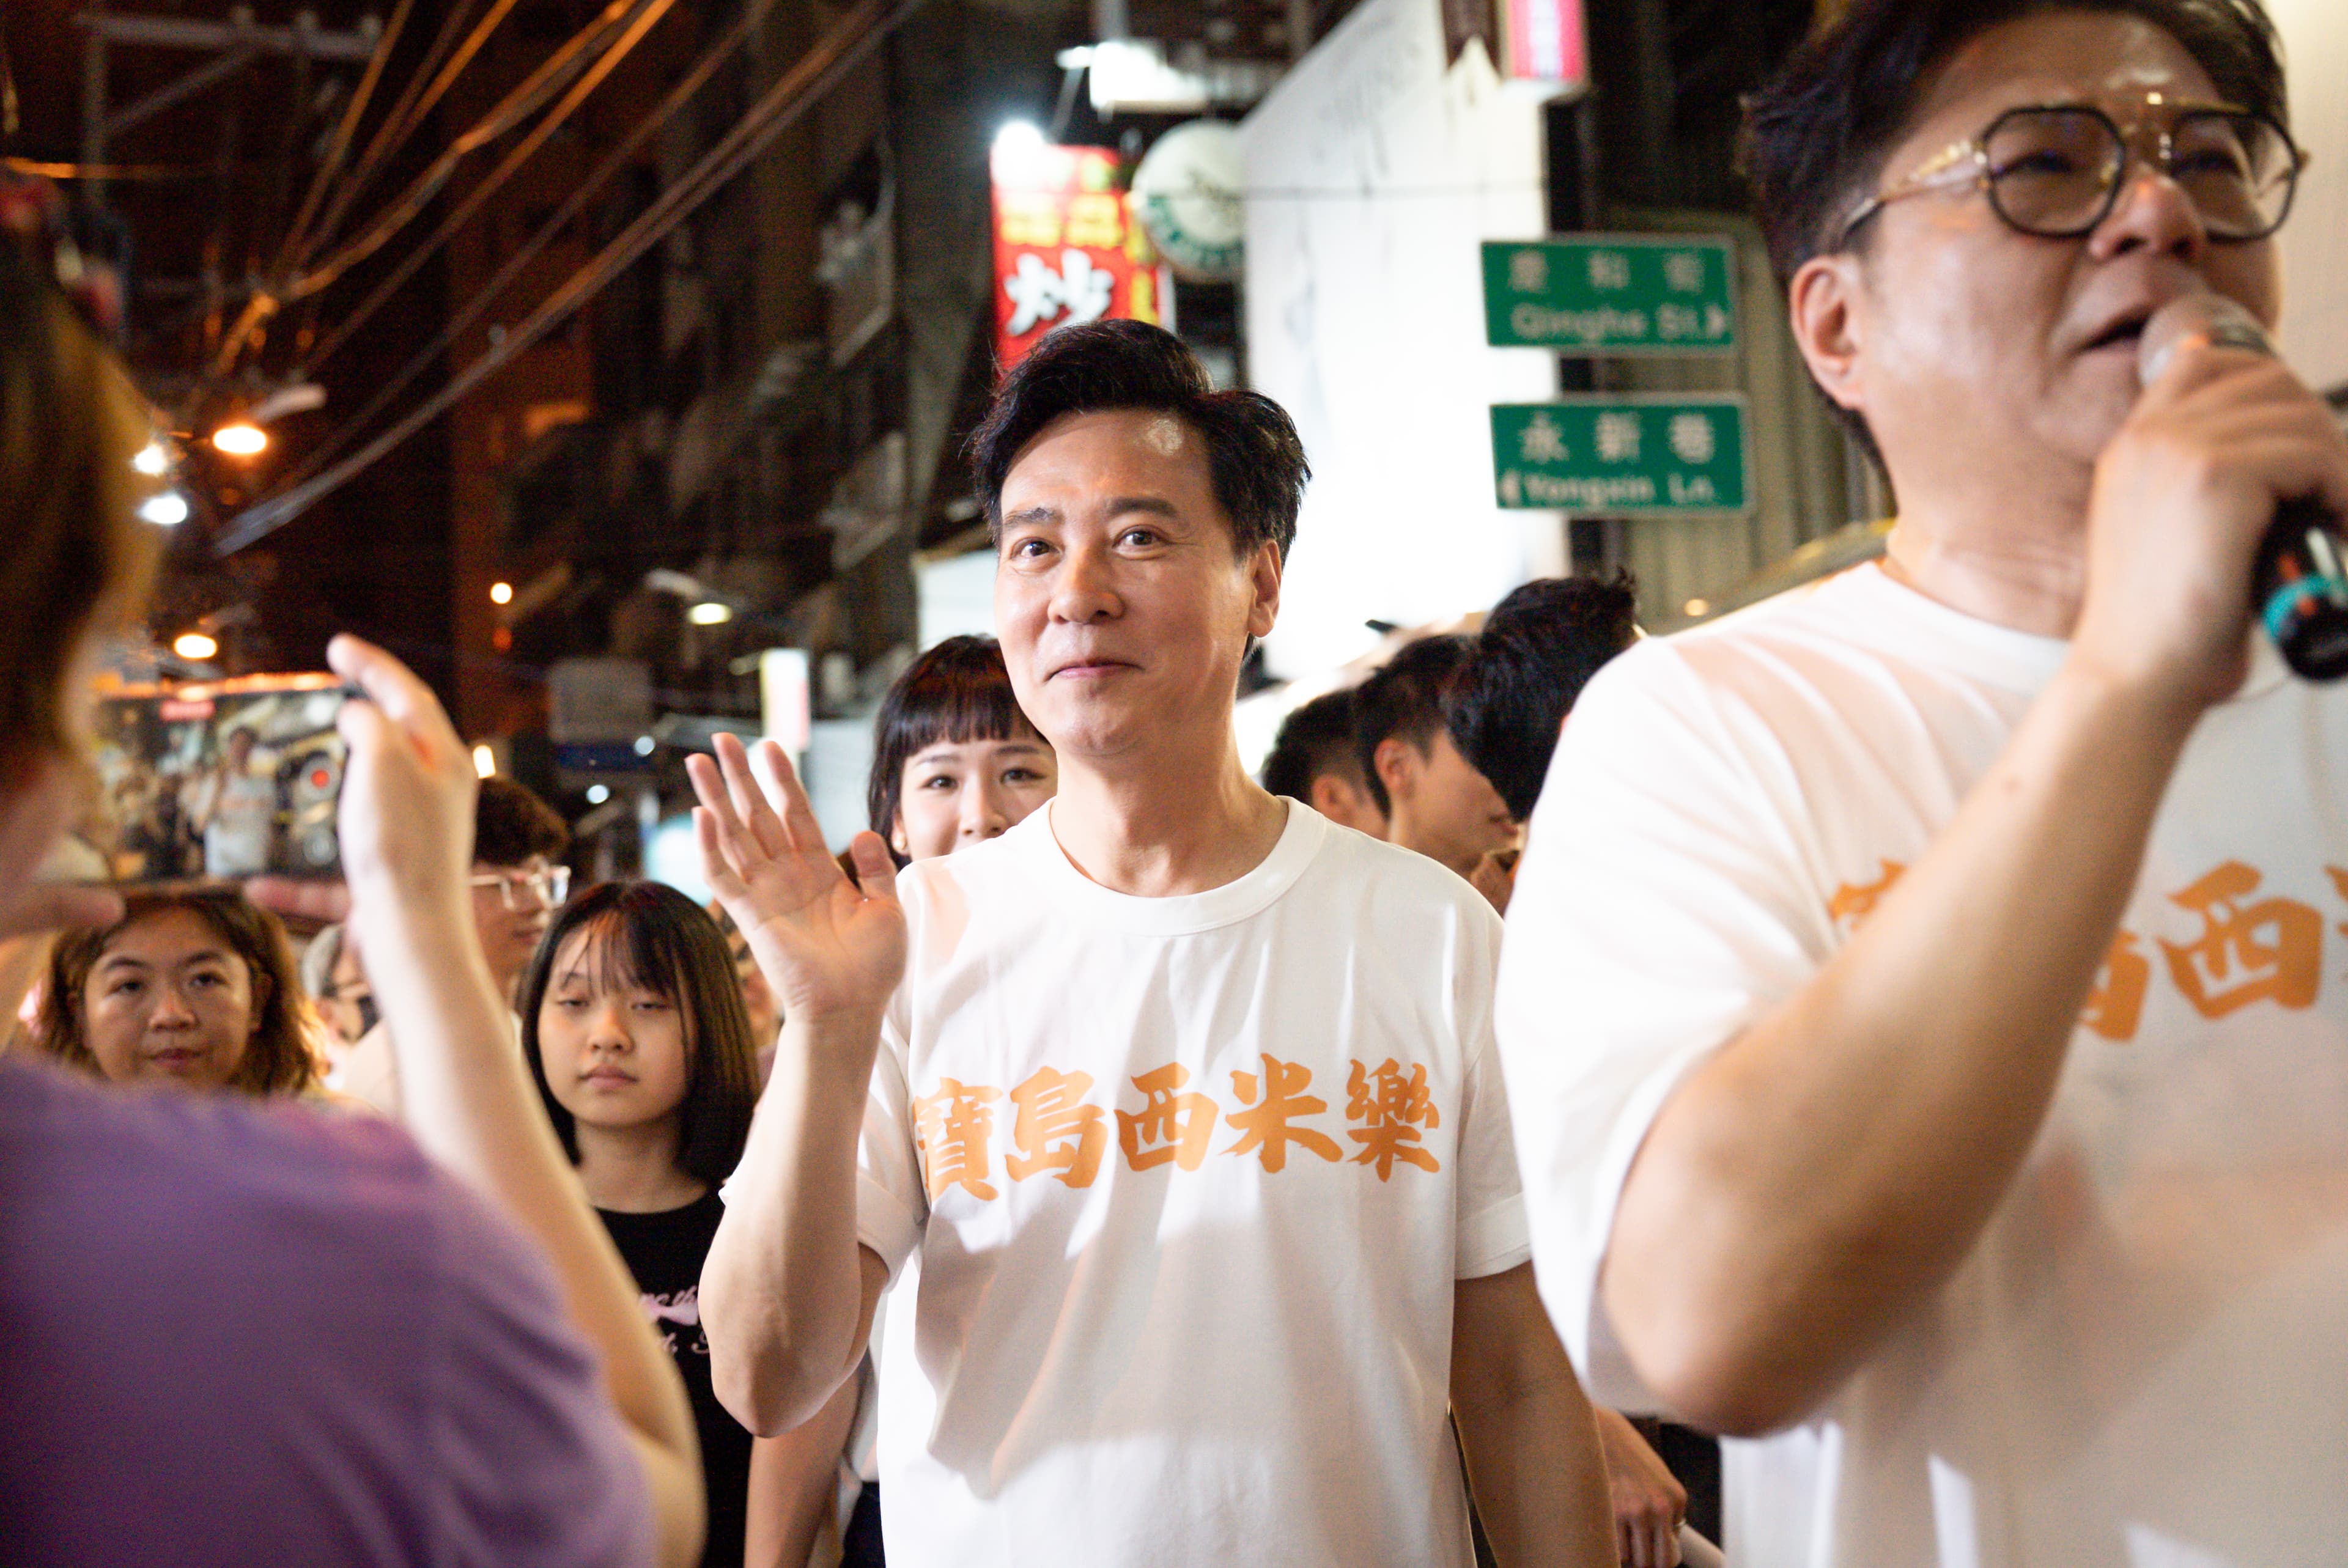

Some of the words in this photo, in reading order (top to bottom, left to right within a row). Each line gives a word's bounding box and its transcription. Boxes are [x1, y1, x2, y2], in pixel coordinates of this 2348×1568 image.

[912, 1052, 1441, 1201] 寶島西米樂
